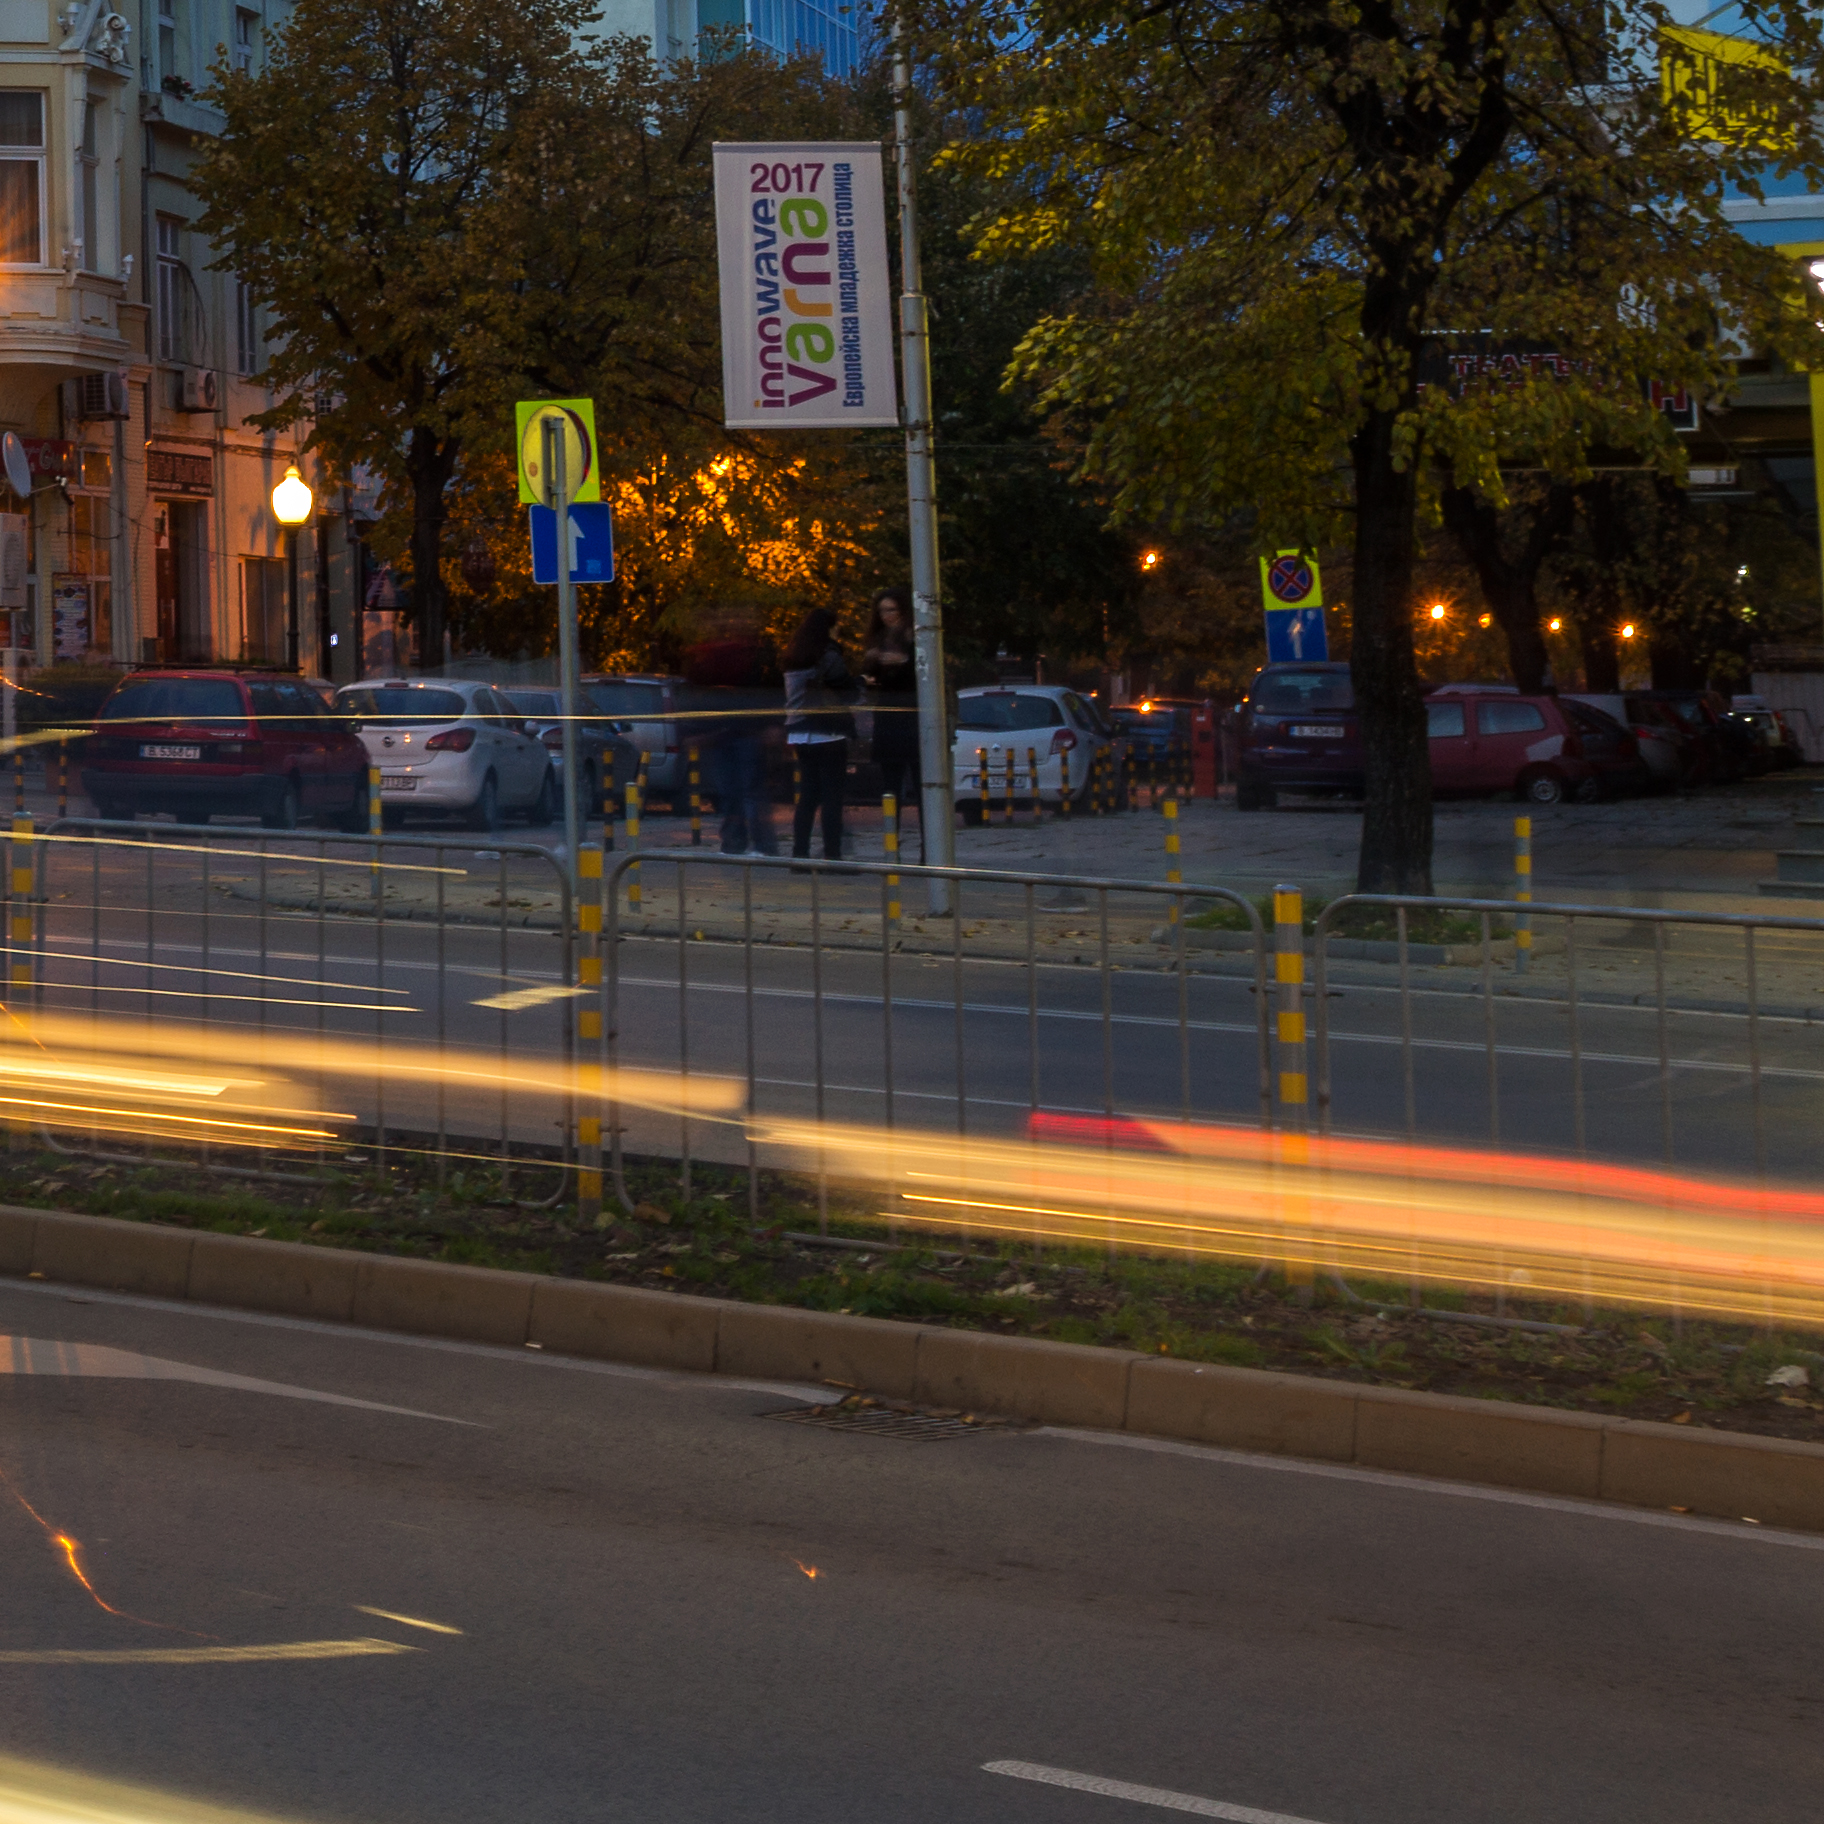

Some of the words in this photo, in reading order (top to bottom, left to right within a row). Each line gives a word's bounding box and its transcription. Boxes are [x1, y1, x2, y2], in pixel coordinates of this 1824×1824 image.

[750, 162, 825, 194] 2017
[832, 161, 855, 228] столица
[752, 198, 786, 408] innowave
[836, 230, 860, 314] младежка
[839, 316, 865, 408] Европейска
